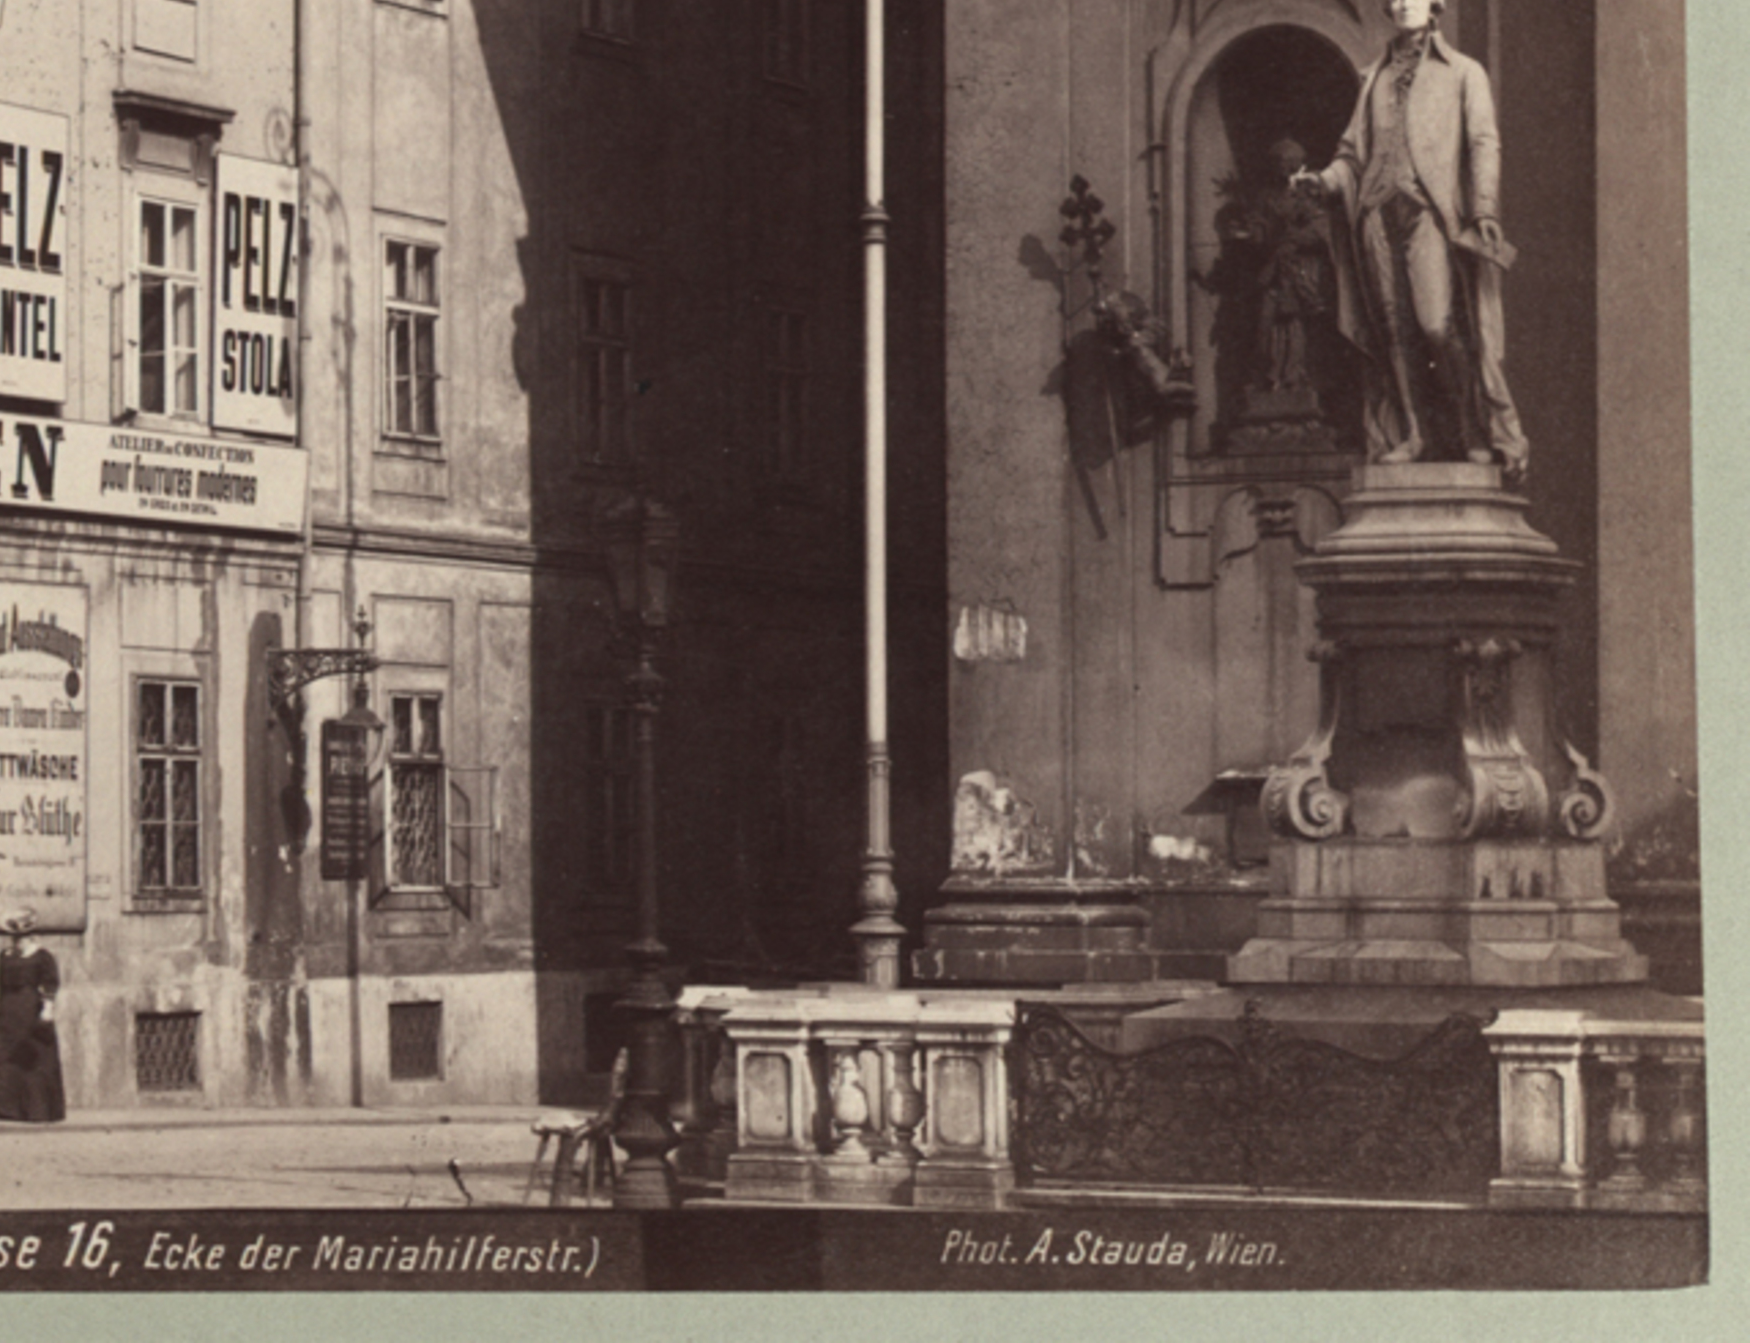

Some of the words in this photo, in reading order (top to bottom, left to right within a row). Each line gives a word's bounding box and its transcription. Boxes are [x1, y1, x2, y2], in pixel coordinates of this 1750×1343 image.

[223, 191, 296, 319] PELZ
[222, 329, 293, 399] STOLA
[109, 434, 164, 453] ATELIER
